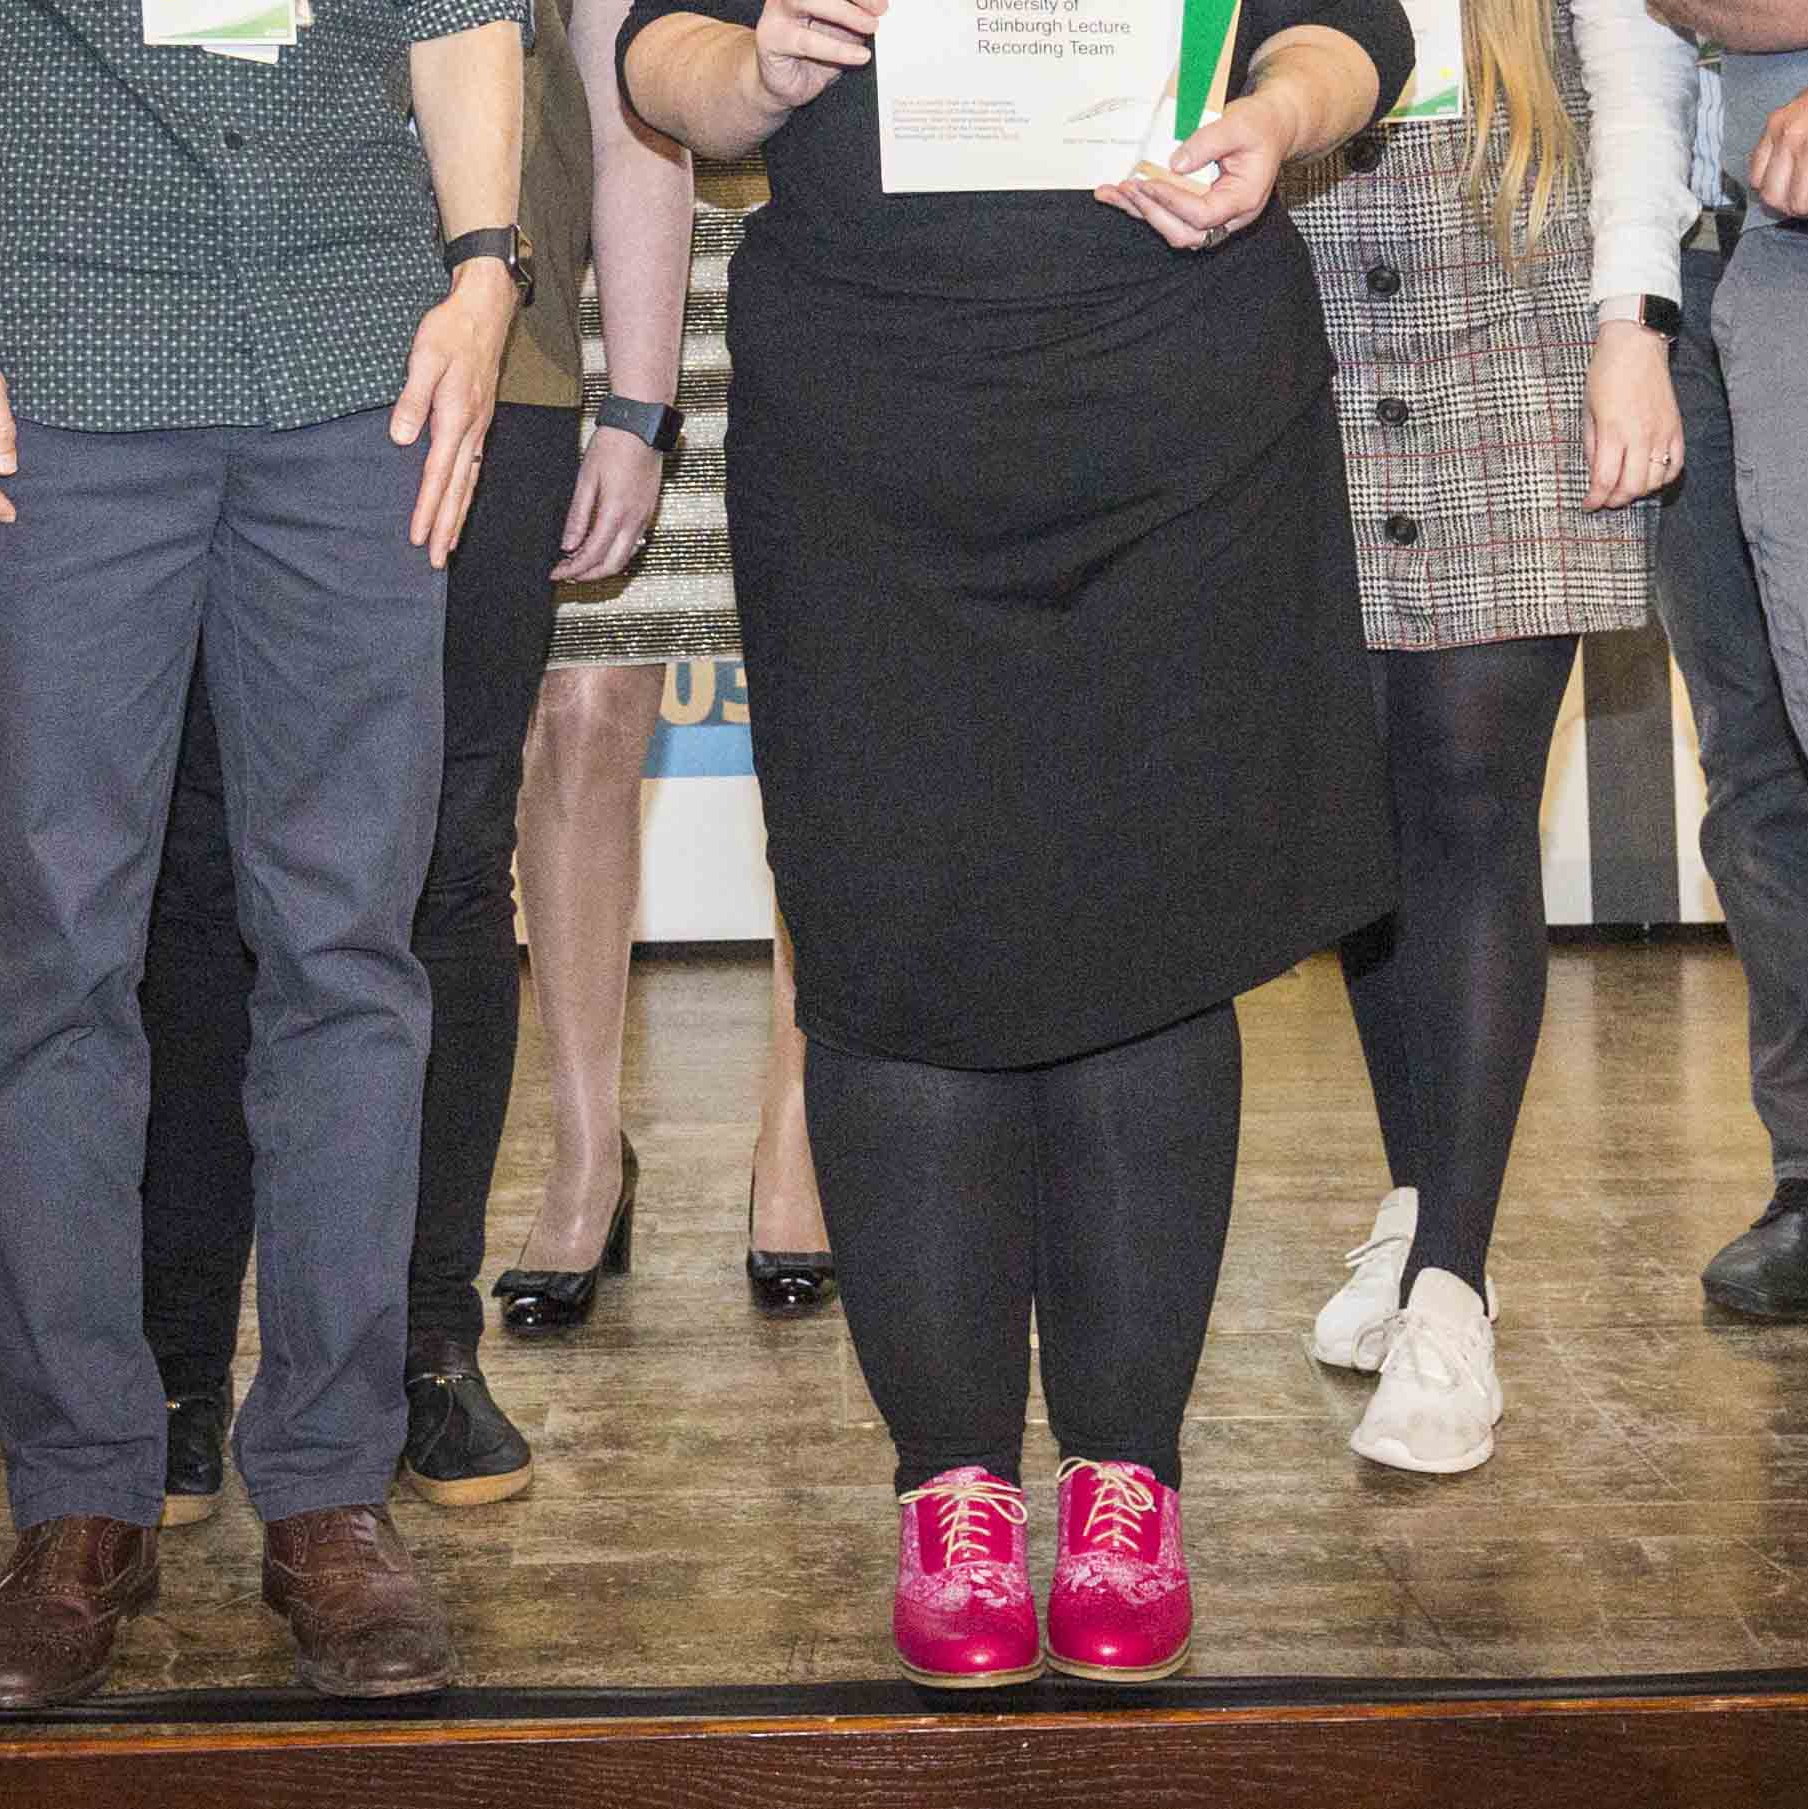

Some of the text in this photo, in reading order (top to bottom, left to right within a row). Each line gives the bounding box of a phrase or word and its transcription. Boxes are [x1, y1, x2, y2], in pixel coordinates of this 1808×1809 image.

[976, 17, 1131, 36] Edinburgh Lecture
[976, 40, 1115, 59] Recording Team
